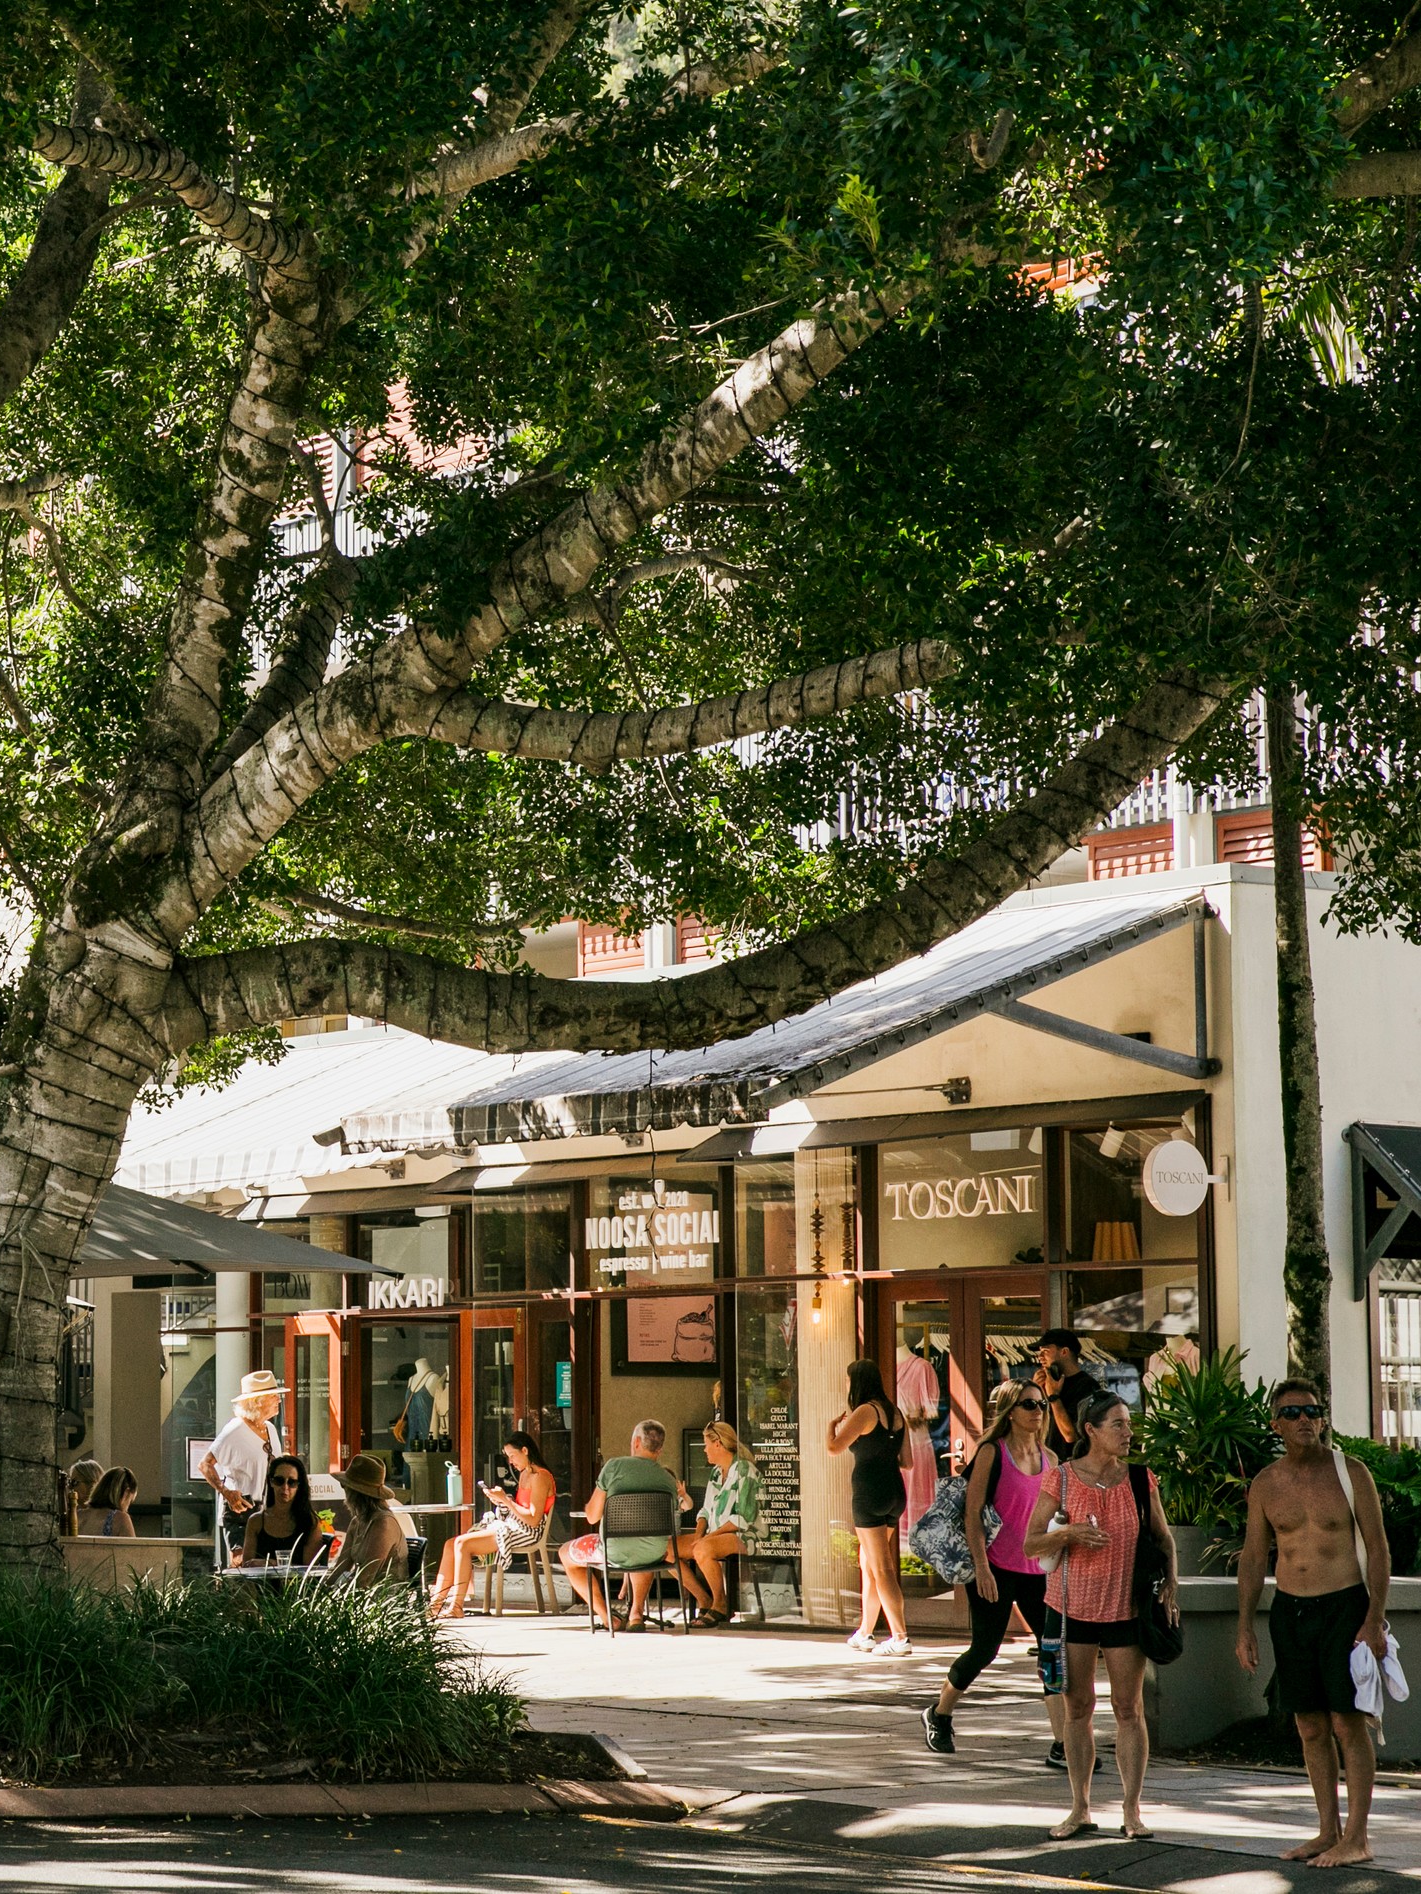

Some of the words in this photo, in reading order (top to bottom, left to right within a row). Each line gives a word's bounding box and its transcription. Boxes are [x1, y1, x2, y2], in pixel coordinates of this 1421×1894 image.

[1155, 1170, 1205, 1185] TOSCANI
[618, 1191, 642, 1211] est.
[665, 1190, 690, 1208] 2020
[884, 1174, 1036, 1221] TOSCANI
[584, 1214, 650, 1250] NOOSA
[654, 1210, 721, 1247] SOCIAL
[599, 1256, 650, 1277] espresso
[659, 1250, 687, 1270] wine
[688, 1249, 710, 1268] bar
[367, 1277, 446, 1310] IKKARI
[310, 1484, 336, 1494] SOCIAL
